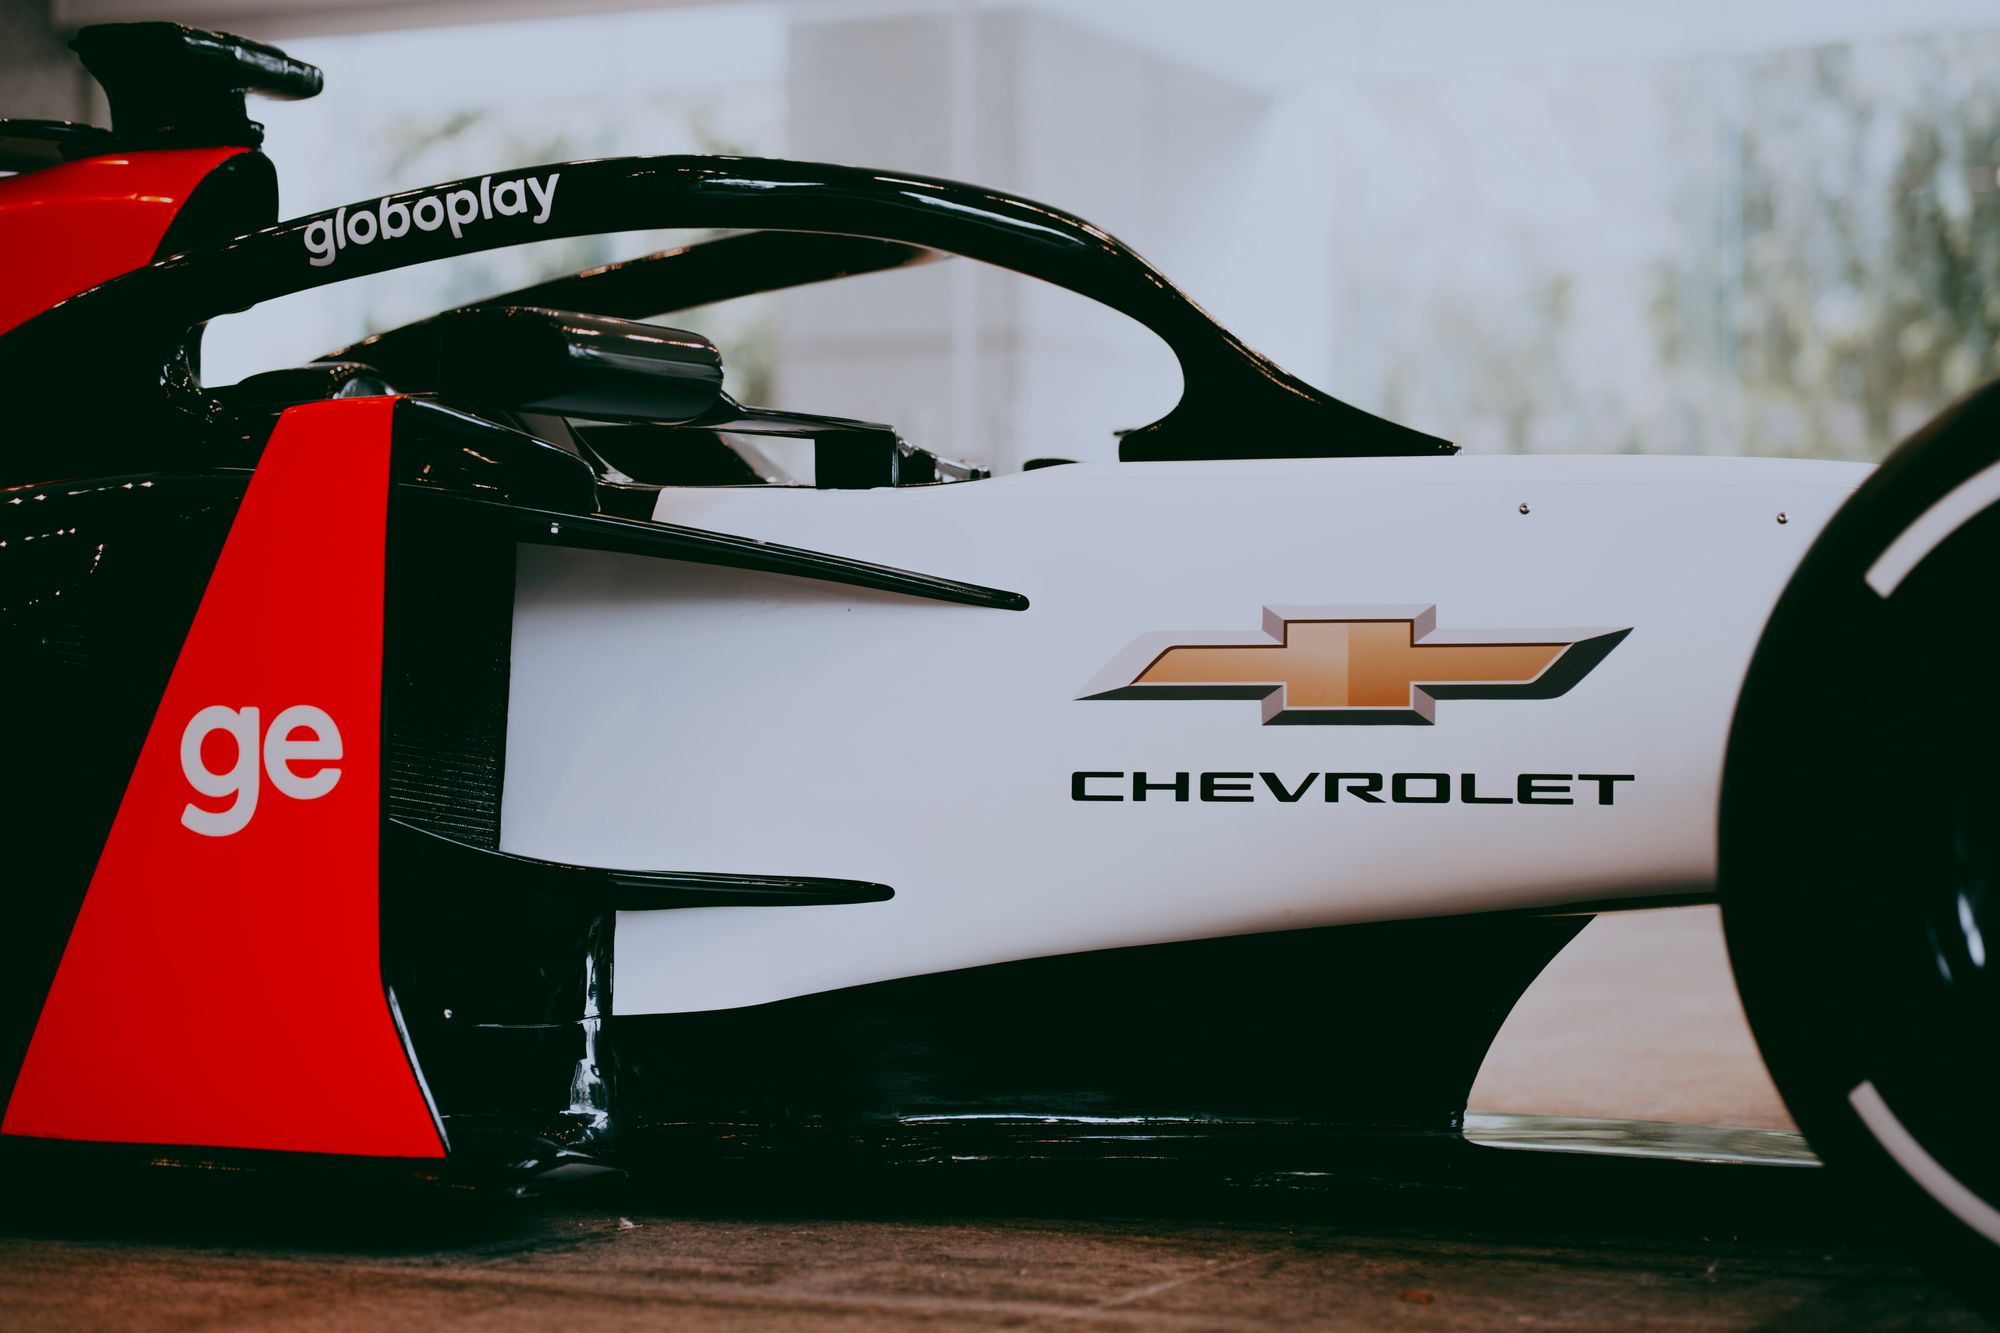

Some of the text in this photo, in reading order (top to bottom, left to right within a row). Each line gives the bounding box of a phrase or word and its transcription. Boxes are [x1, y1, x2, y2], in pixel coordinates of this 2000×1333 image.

[304, 174, 559, 266] globoplay
[180, 705, 343, 837] ge
[1072, 772, 1636, 805] CHEVROLET
